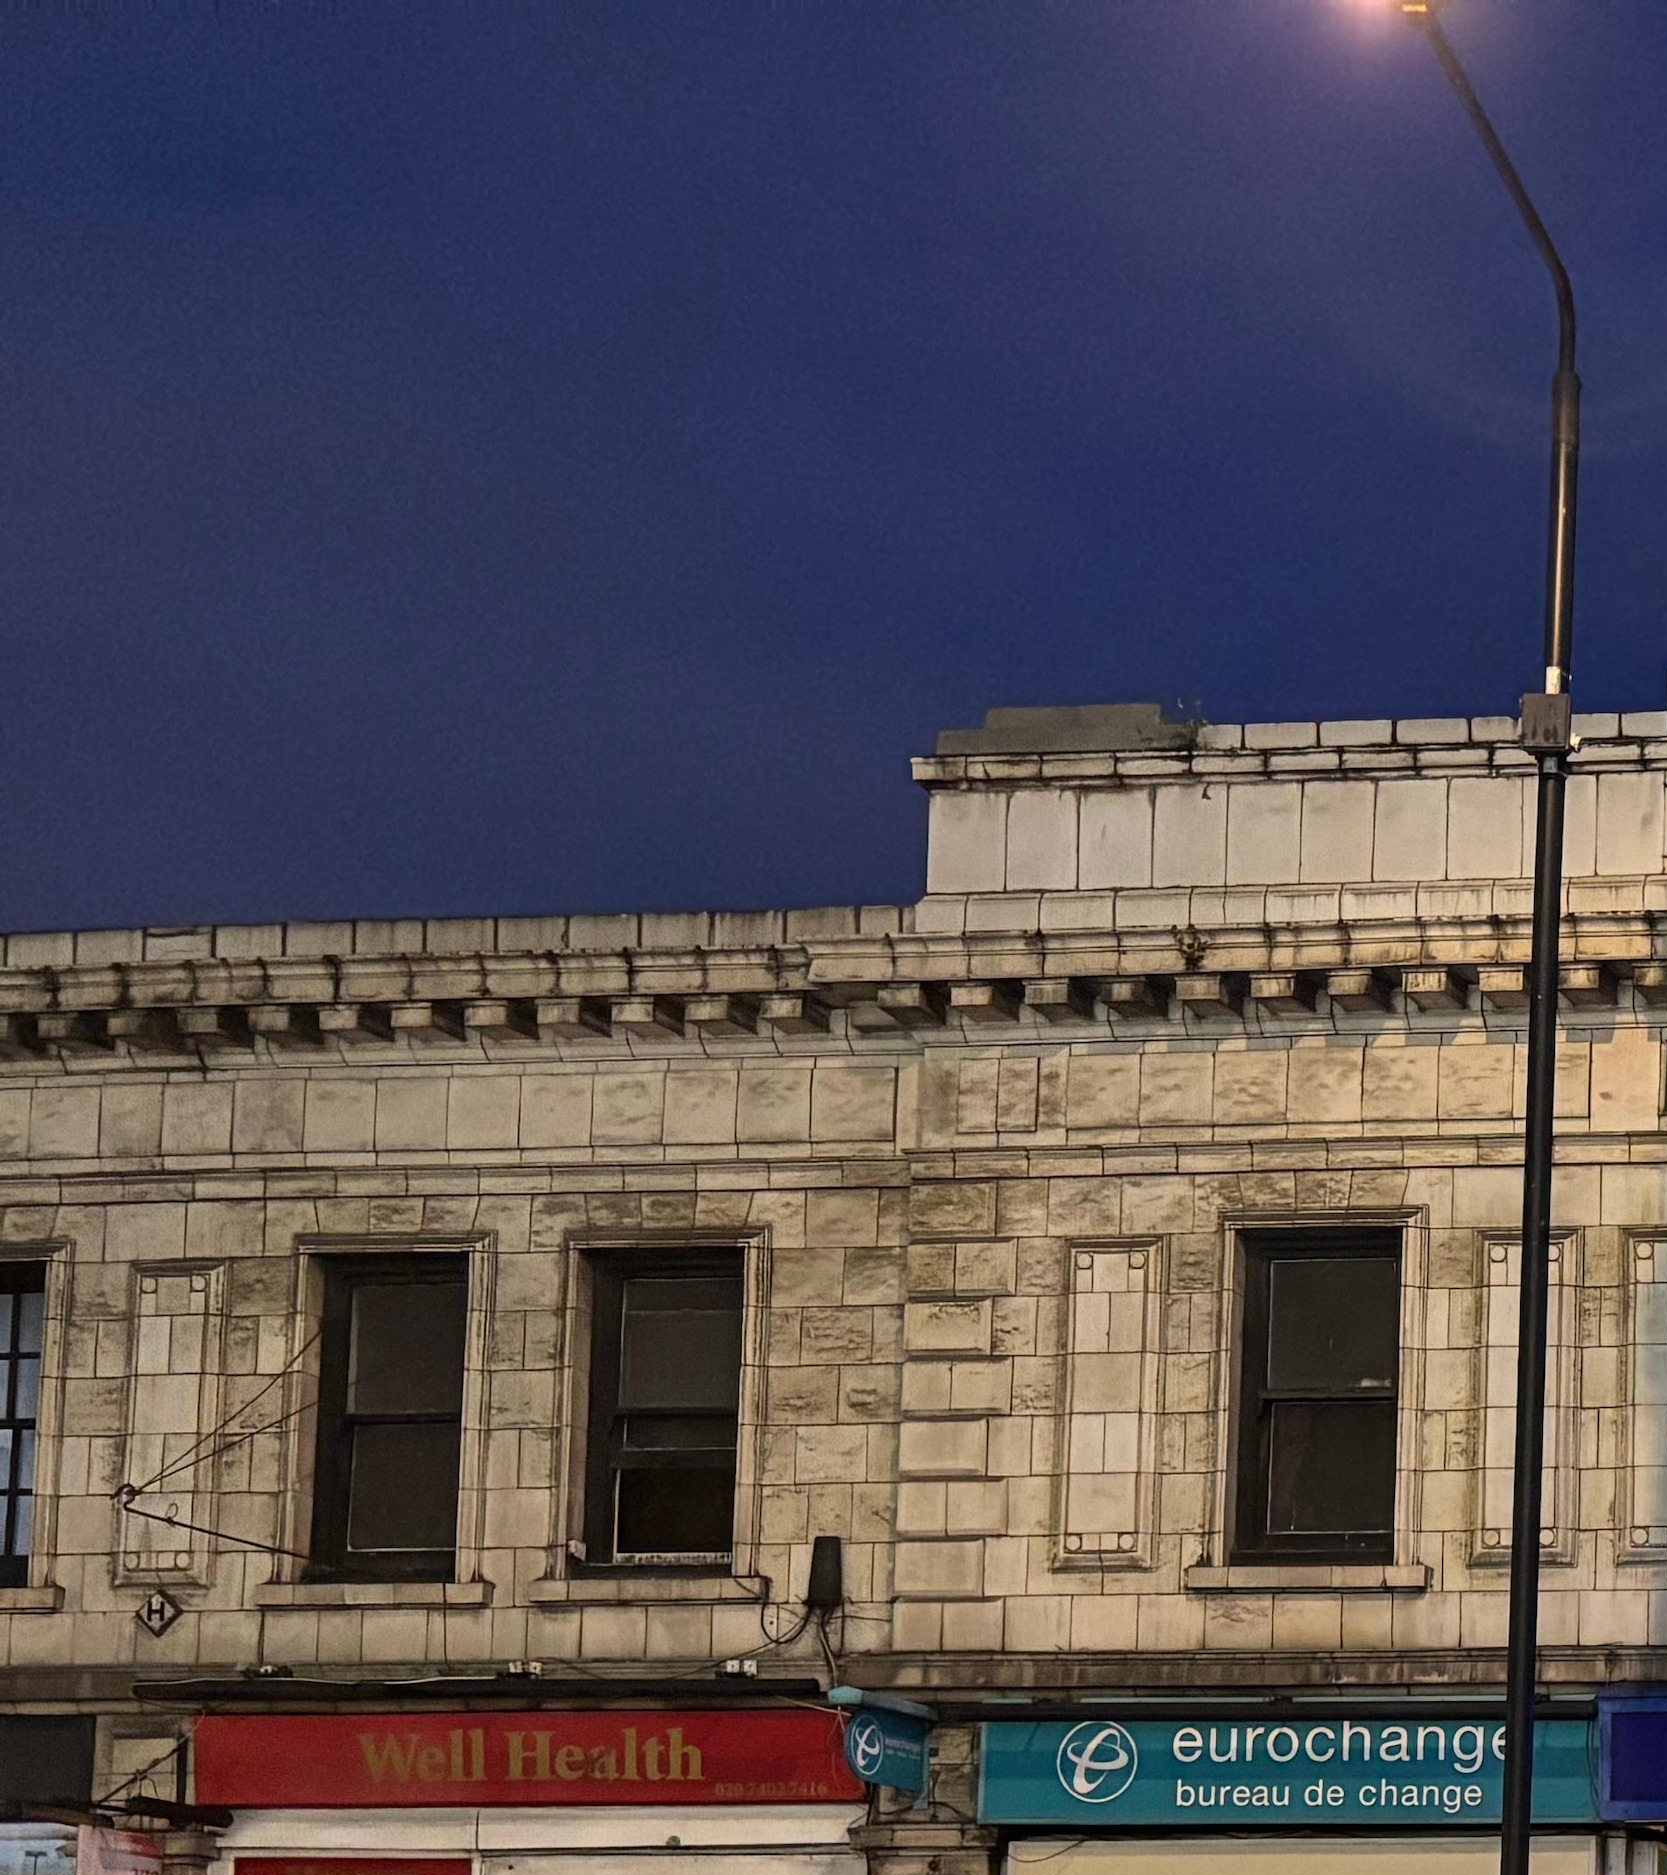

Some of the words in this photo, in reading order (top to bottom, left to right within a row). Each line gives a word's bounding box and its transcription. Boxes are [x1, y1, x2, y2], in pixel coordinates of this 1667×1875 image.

[147, 1600, 165, 1622] H
[357, 1728, 488, 1782] Well
[504, 1728, 706, 1781] Health
[1176, 1779, 1290, 1807] bureau
[1303, 1779, 1345, 1807] de
[1358, 1778, 1483, 1814] change
